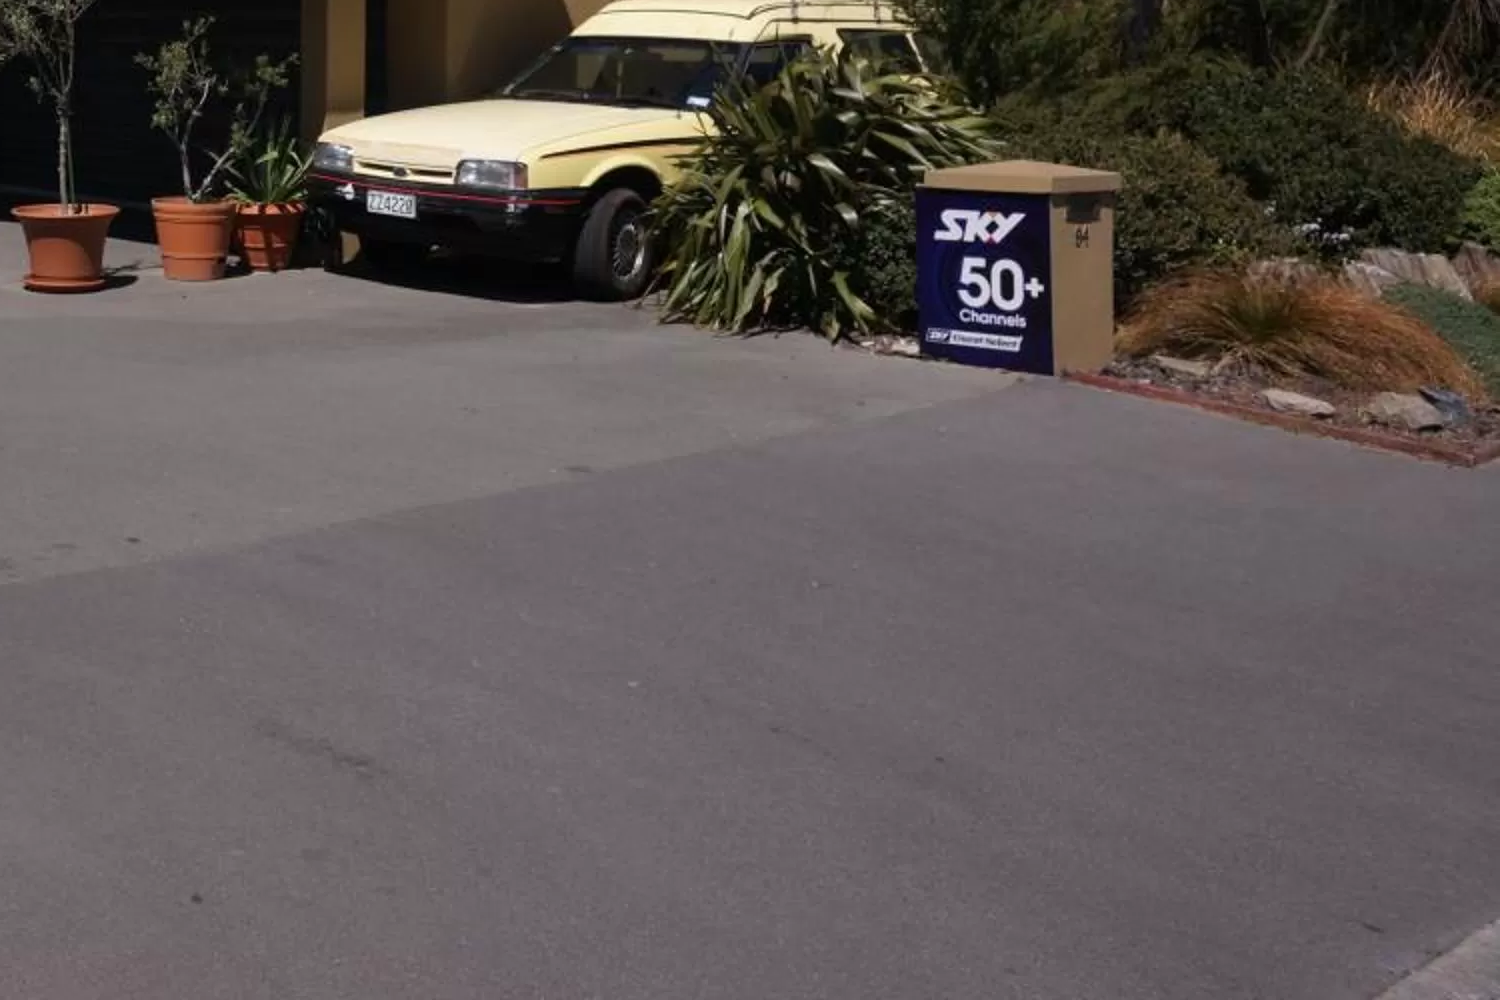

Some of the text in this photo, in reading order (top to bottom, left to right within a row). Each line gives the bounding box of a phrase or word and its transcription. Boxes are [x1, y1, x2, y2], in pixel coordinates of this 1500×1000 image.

[933, 209, 1026, 244] SKY
[957, 256, 1045, 311] 50+
[959, 308, 1027, 328] Channels
